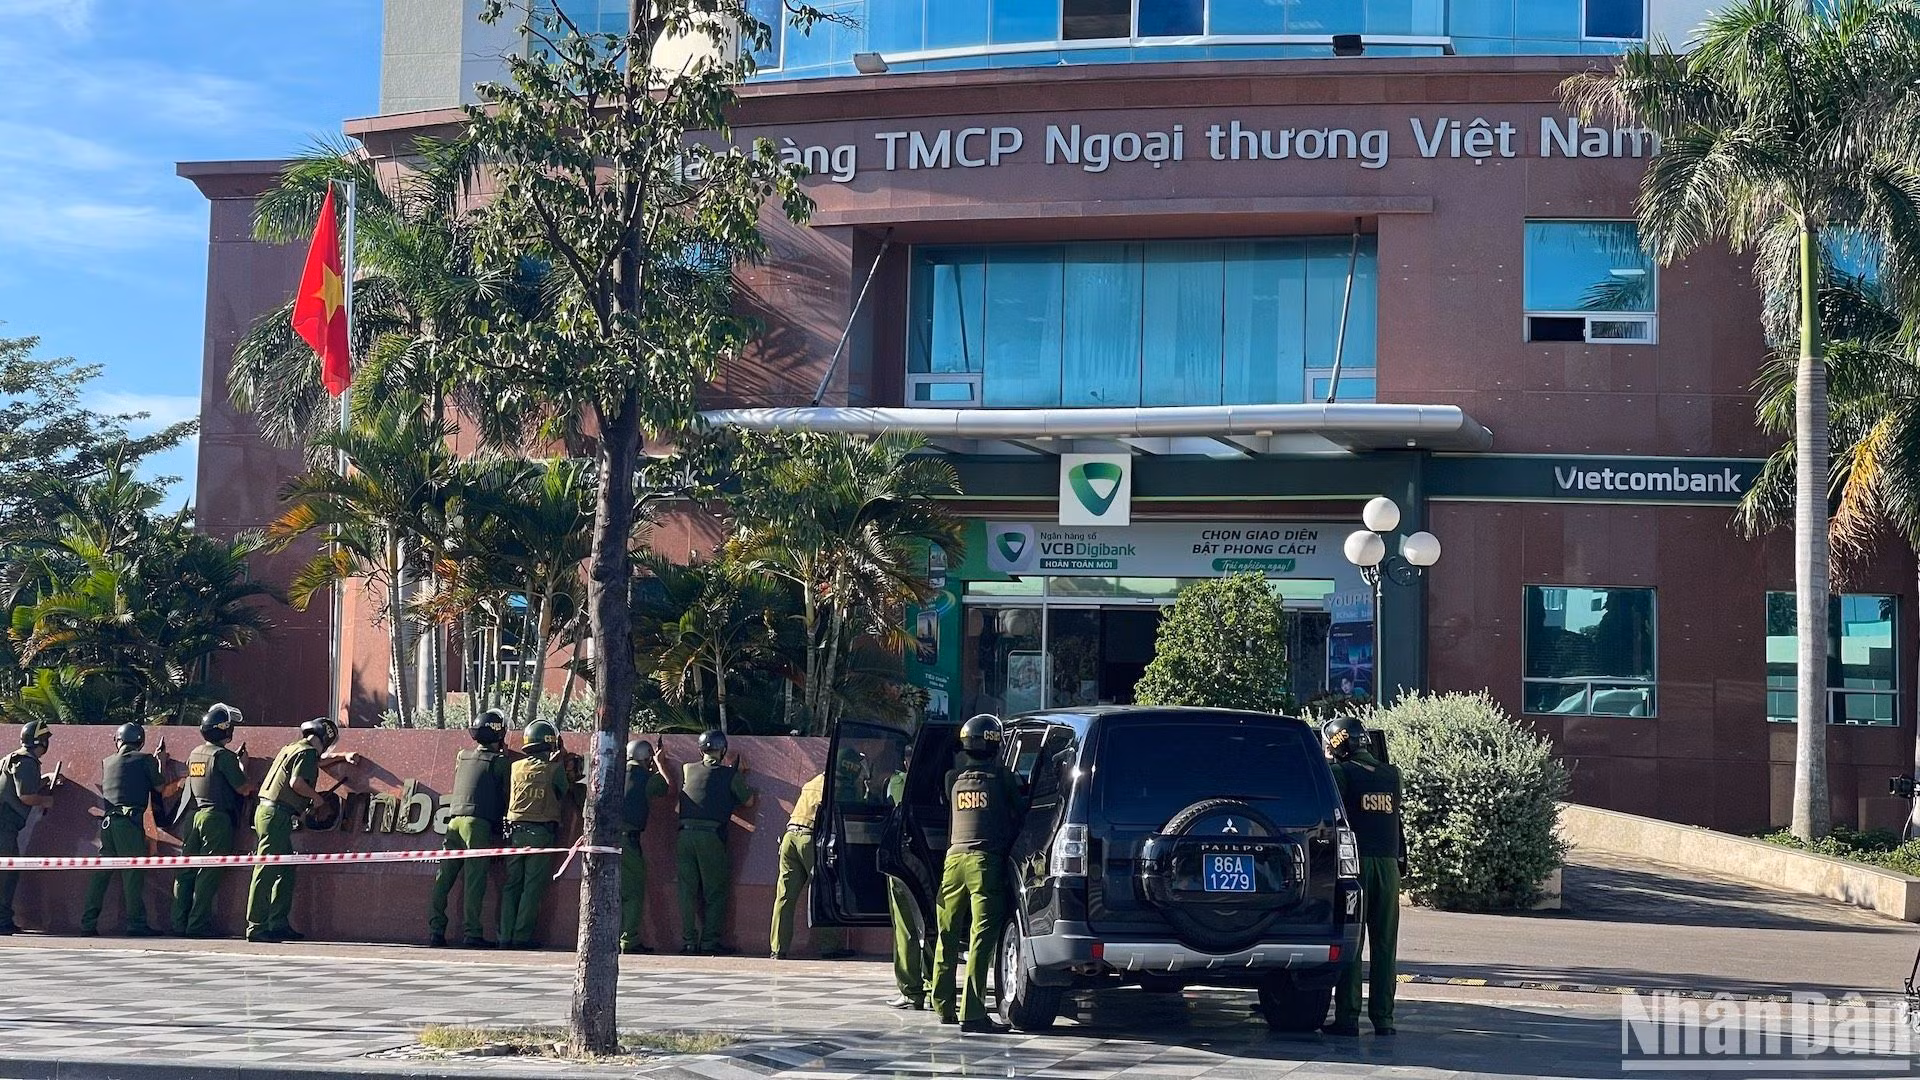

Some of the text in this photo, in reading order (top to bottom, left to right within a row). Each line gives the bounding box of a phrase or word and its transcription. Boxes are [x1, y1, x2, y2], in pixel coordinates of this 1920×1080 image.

[875, 127, 1024, 171] TMCP
[1045, 124, 1183, 173] Ngoại
[1205, 120, 1390, 169] thương
[1410, 116, 1516, 166] Việt
[1540, 116, 1661, 158] Nam
[1554, 466, 1742, 492] Vietcombank
[1201, 528, 1318, 542] CHỌN GIAO DIỆN
[1041, 543, 1136, 557] VCB Digibank
[1192, 542, 1317, 556] BẬT PHONG CÁCH
[957, 791, 988, 809] CSHS
[1363, 793, 1393, 814] CSHS
[1214, 856, 1243, 873] 86A
[1210, 873, 1249, 890] 1279
